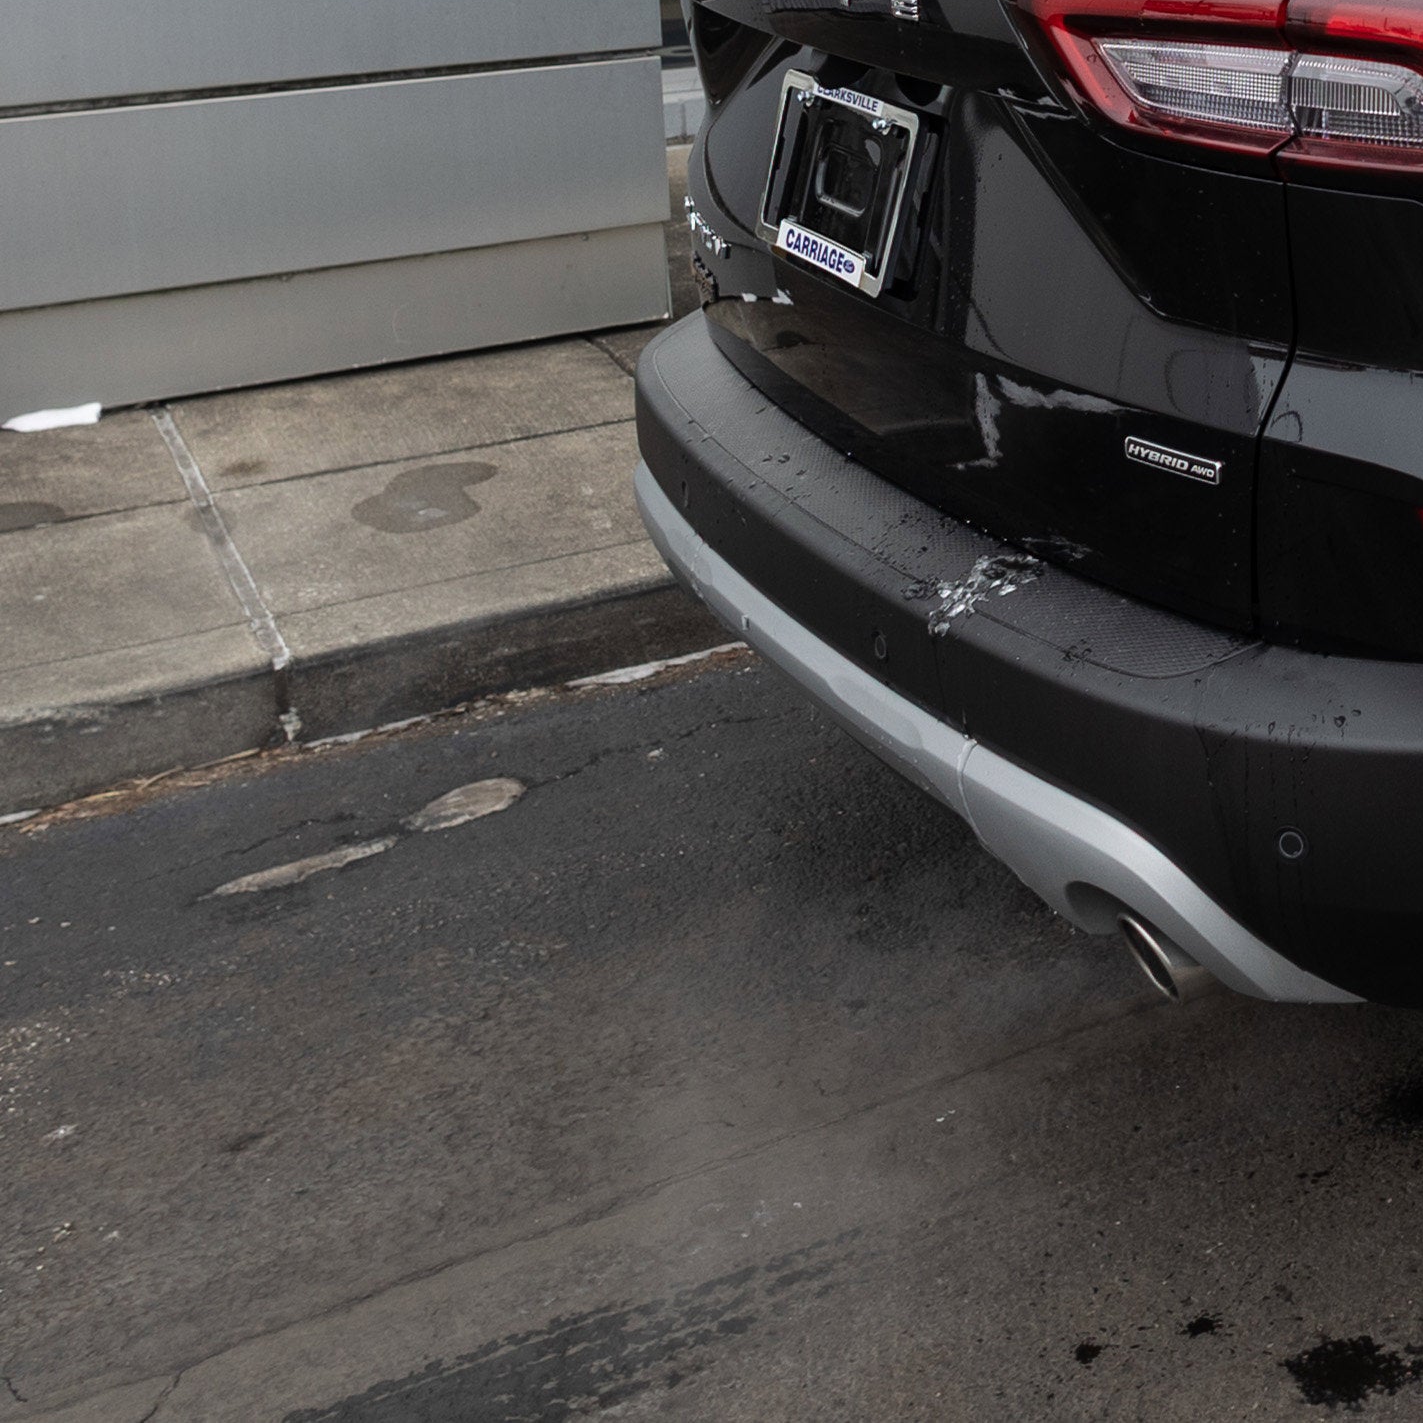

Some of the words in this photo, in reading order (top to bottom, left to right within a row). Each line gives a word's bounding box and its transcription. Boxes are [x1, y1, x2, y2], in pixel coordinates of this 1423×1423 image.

[785, 229, 845, 273] CARRIAGE
[1128, 444, 1189, 471] HYBRID
[1190, 464, 1215, 478] AWD
